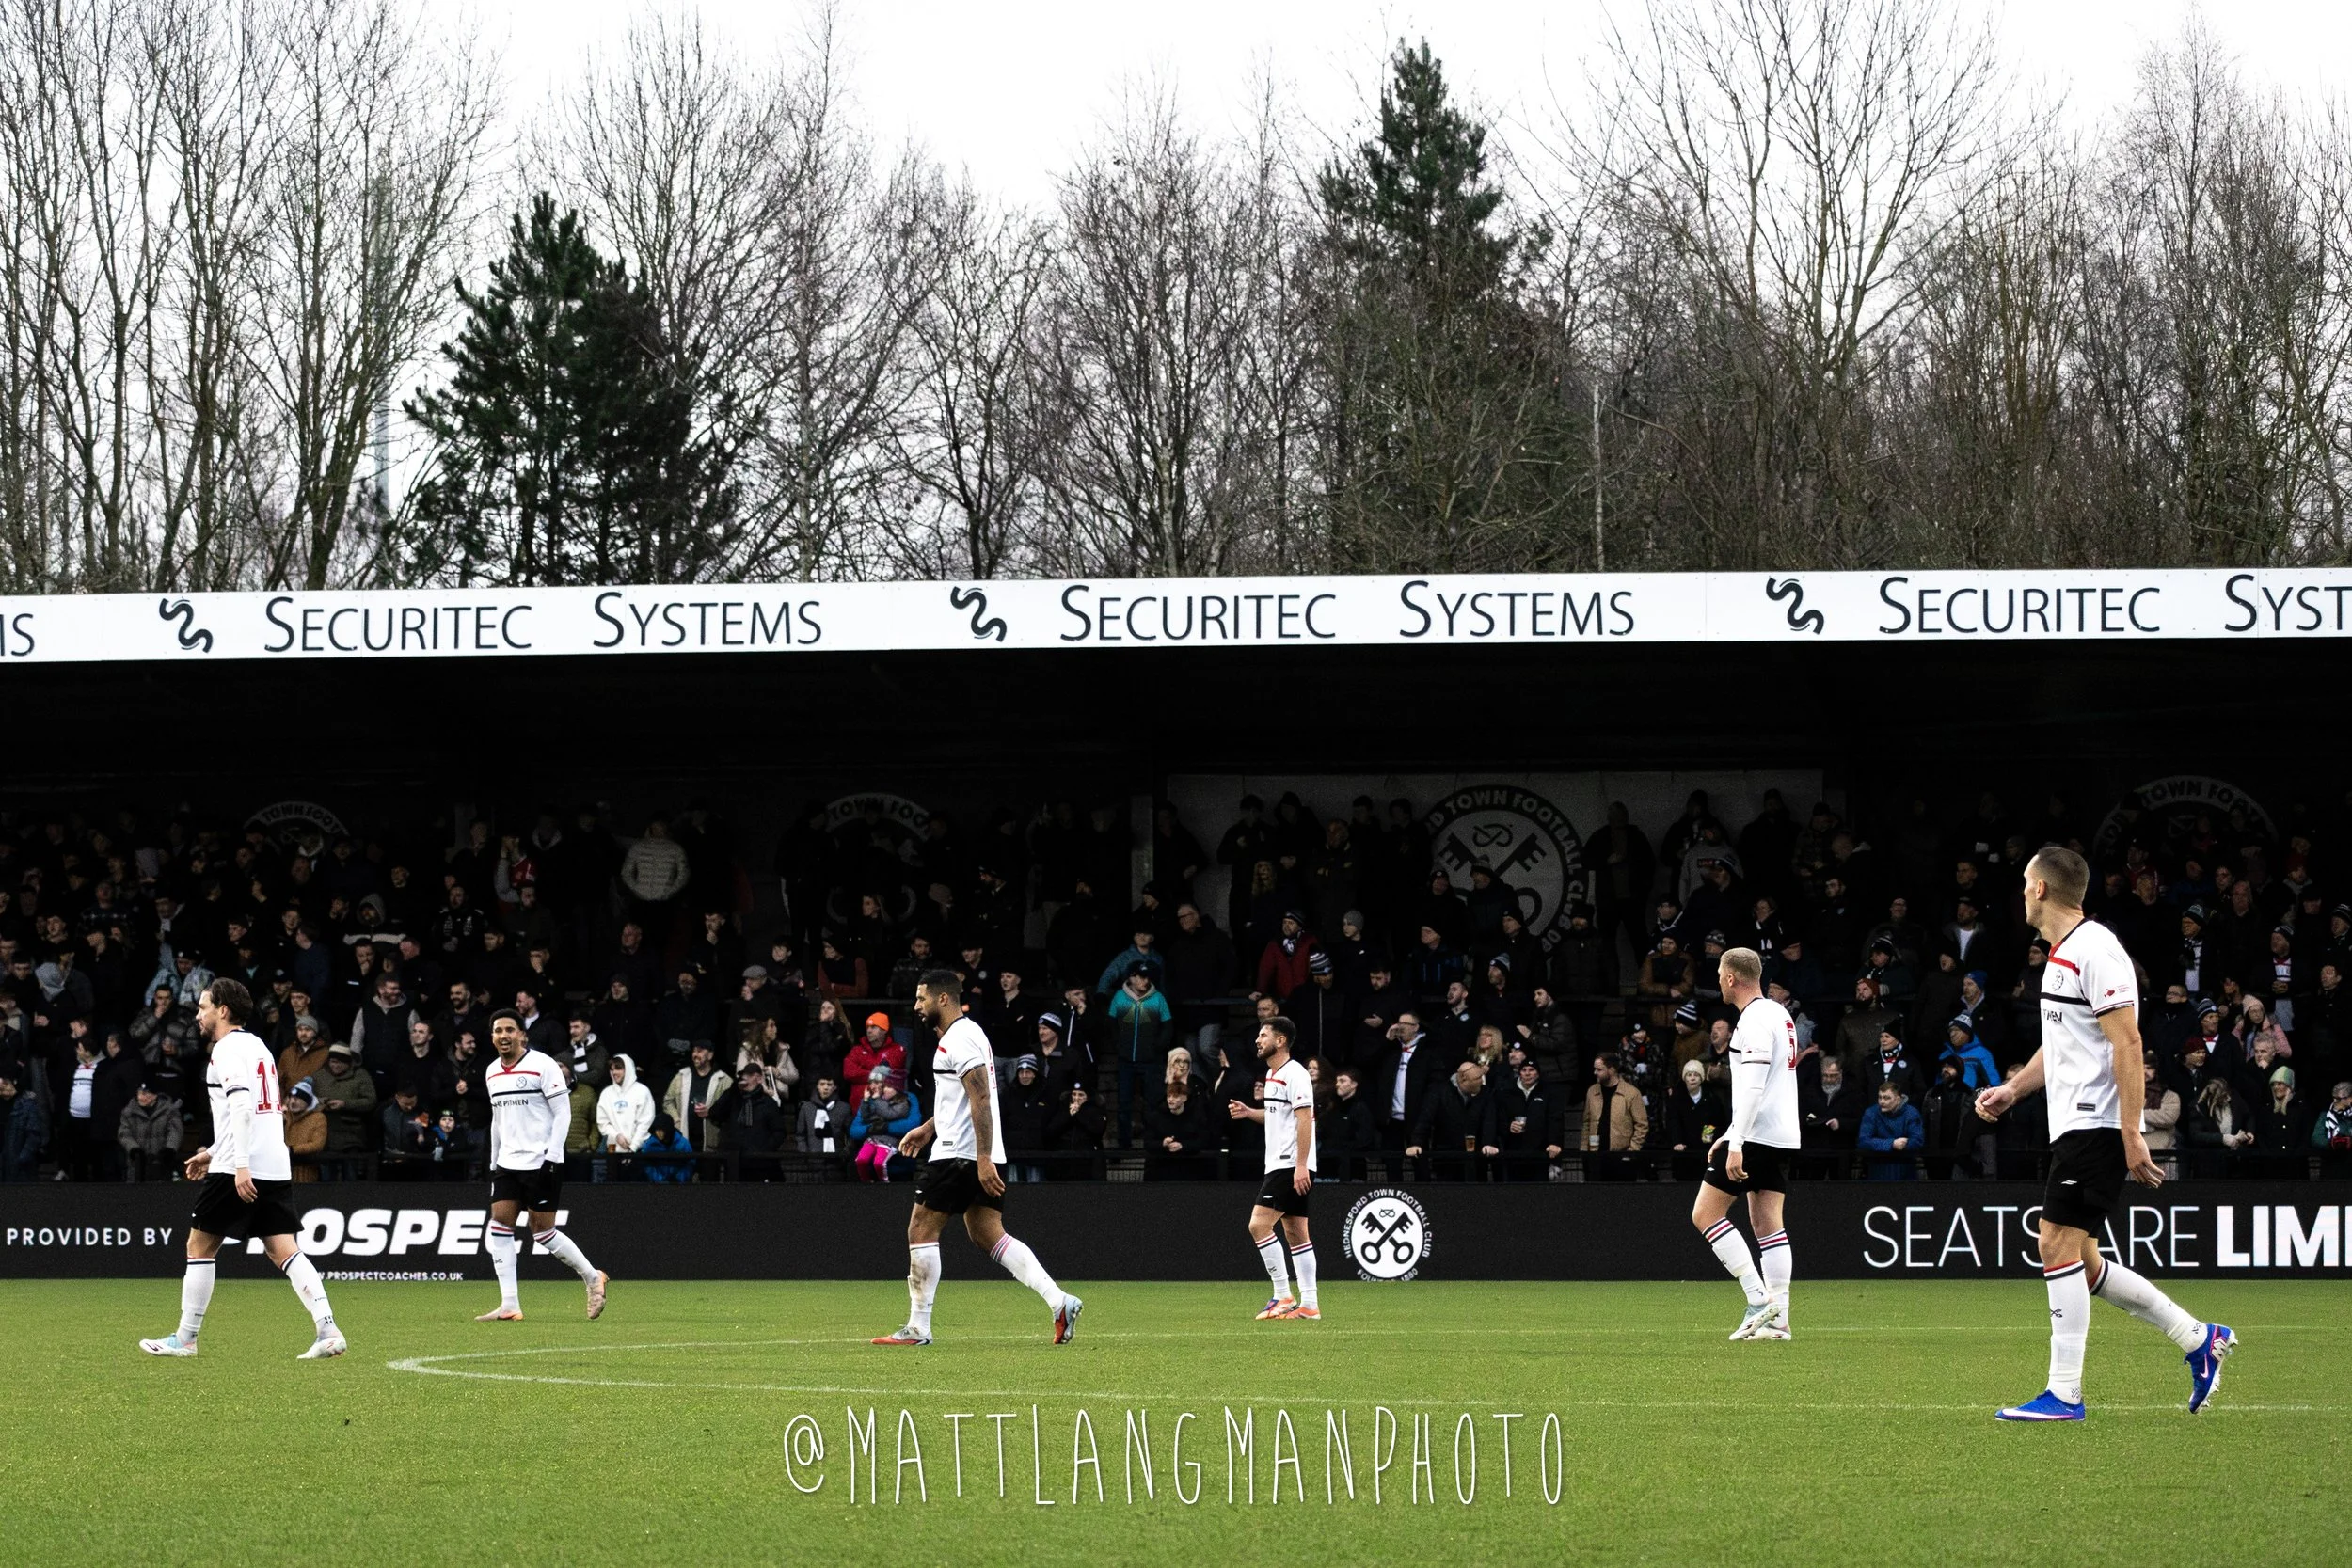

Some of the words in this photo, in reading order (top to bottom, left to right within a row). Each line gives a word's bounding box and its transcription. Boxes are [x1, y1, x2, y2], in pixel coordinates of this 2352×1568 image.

[264, 597, 532, 653] SECURITEC
[594, 592, 822, 648] SYSTEMS
[1060, 585, 1336, 641] SECURITEC
[1400, 580, 1634, 638] SYSTEMS
[1879, 576, 2161, 634] SECURITEC
[2224, 574, 2352, 632] SYST
[1445, 790, 1508, 816] TOWN
[1511, 793, 1582, 876] FOOTBALL
[7, 1227, 131, 1246] PROVIDED
[144, 1227, 173, 1246] BY
[1343, 1196, 1369, 1259] HEDNESFORD
[1367, 1188, 1395, 1199] TOWN
[1395, 1190, 1431, 1229] FOOTBALL
[1422, 1230, 1433, 1259] CLUB
[1864, 1205, 2043, 1268] SEATS
